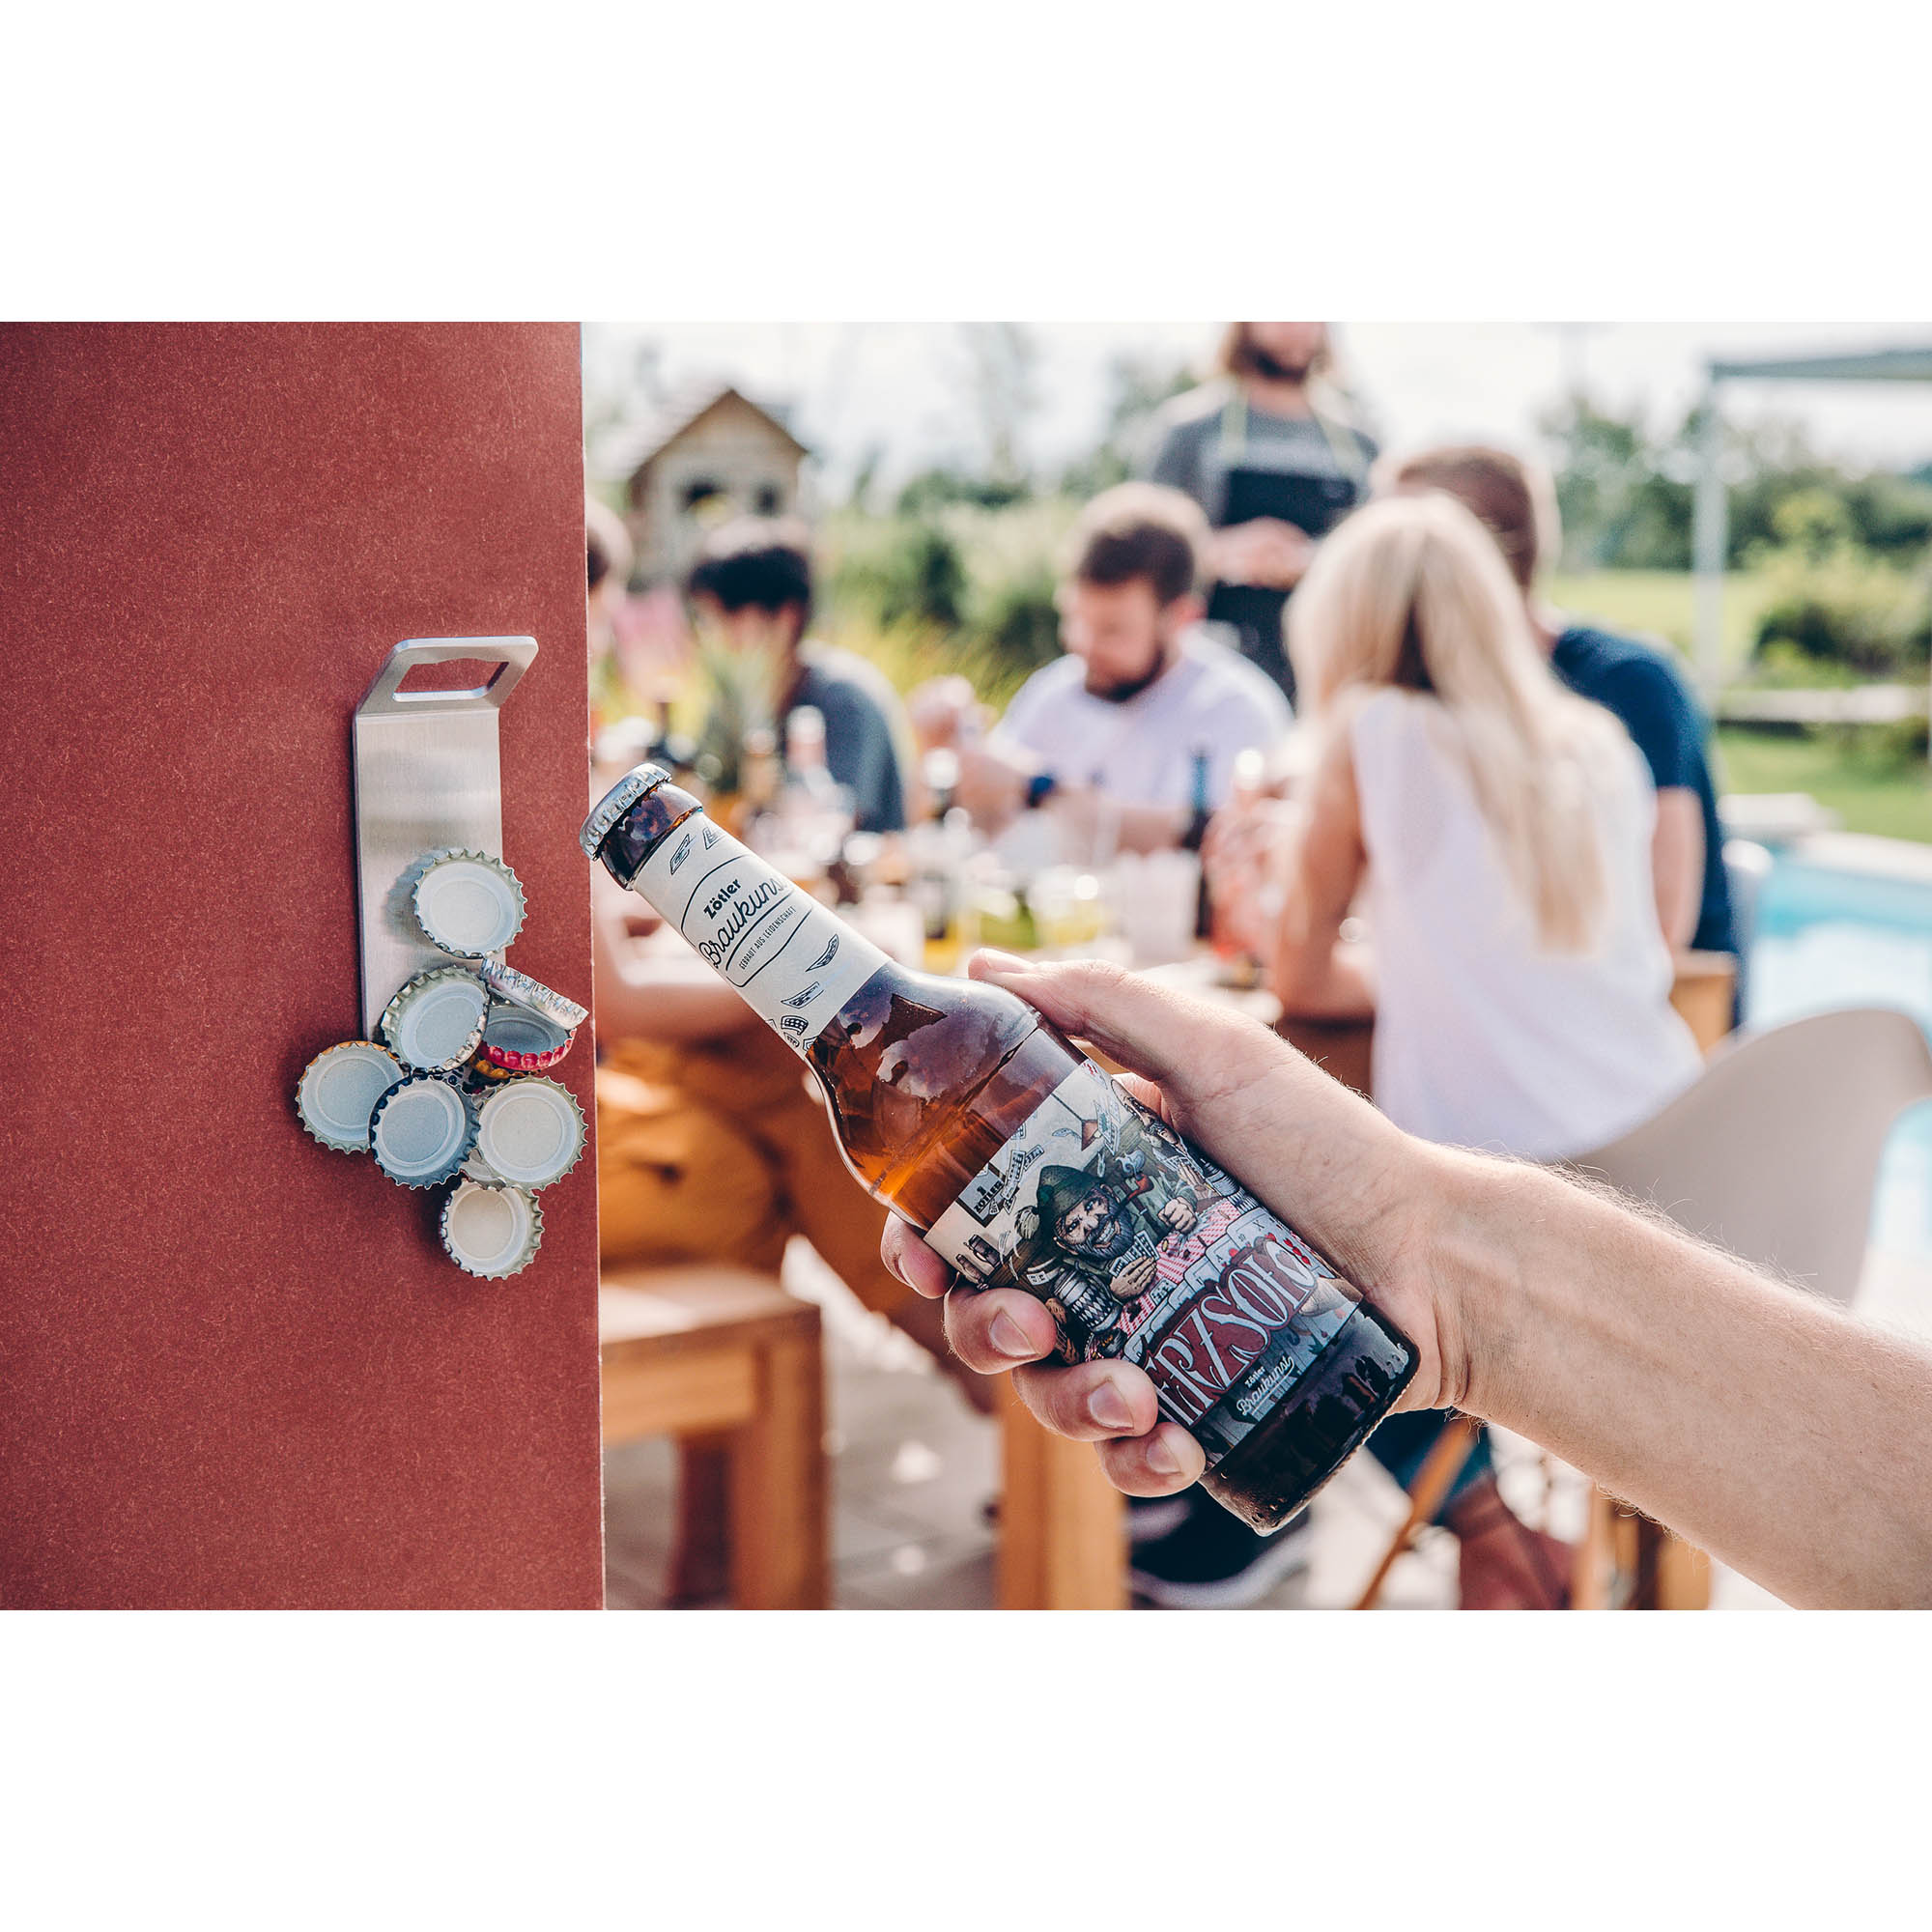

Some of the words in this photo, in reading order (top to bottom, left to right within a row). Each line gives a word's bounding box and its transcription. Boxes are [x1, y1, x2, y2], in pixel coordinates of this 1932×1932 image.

[698, 878, 787, 969] Braukuns
[703, 878, 741, 920] Zötler
[738, 947, 757, 970] GEBRAUT
[753, 936, 766, 950] AUS
[762, 906, 797, 939] LEIDENSCHAFT
[1145, 1240, 1317, 1426] ERZSOLO
[1236, 1355, 1294, 1416] Braukunst
